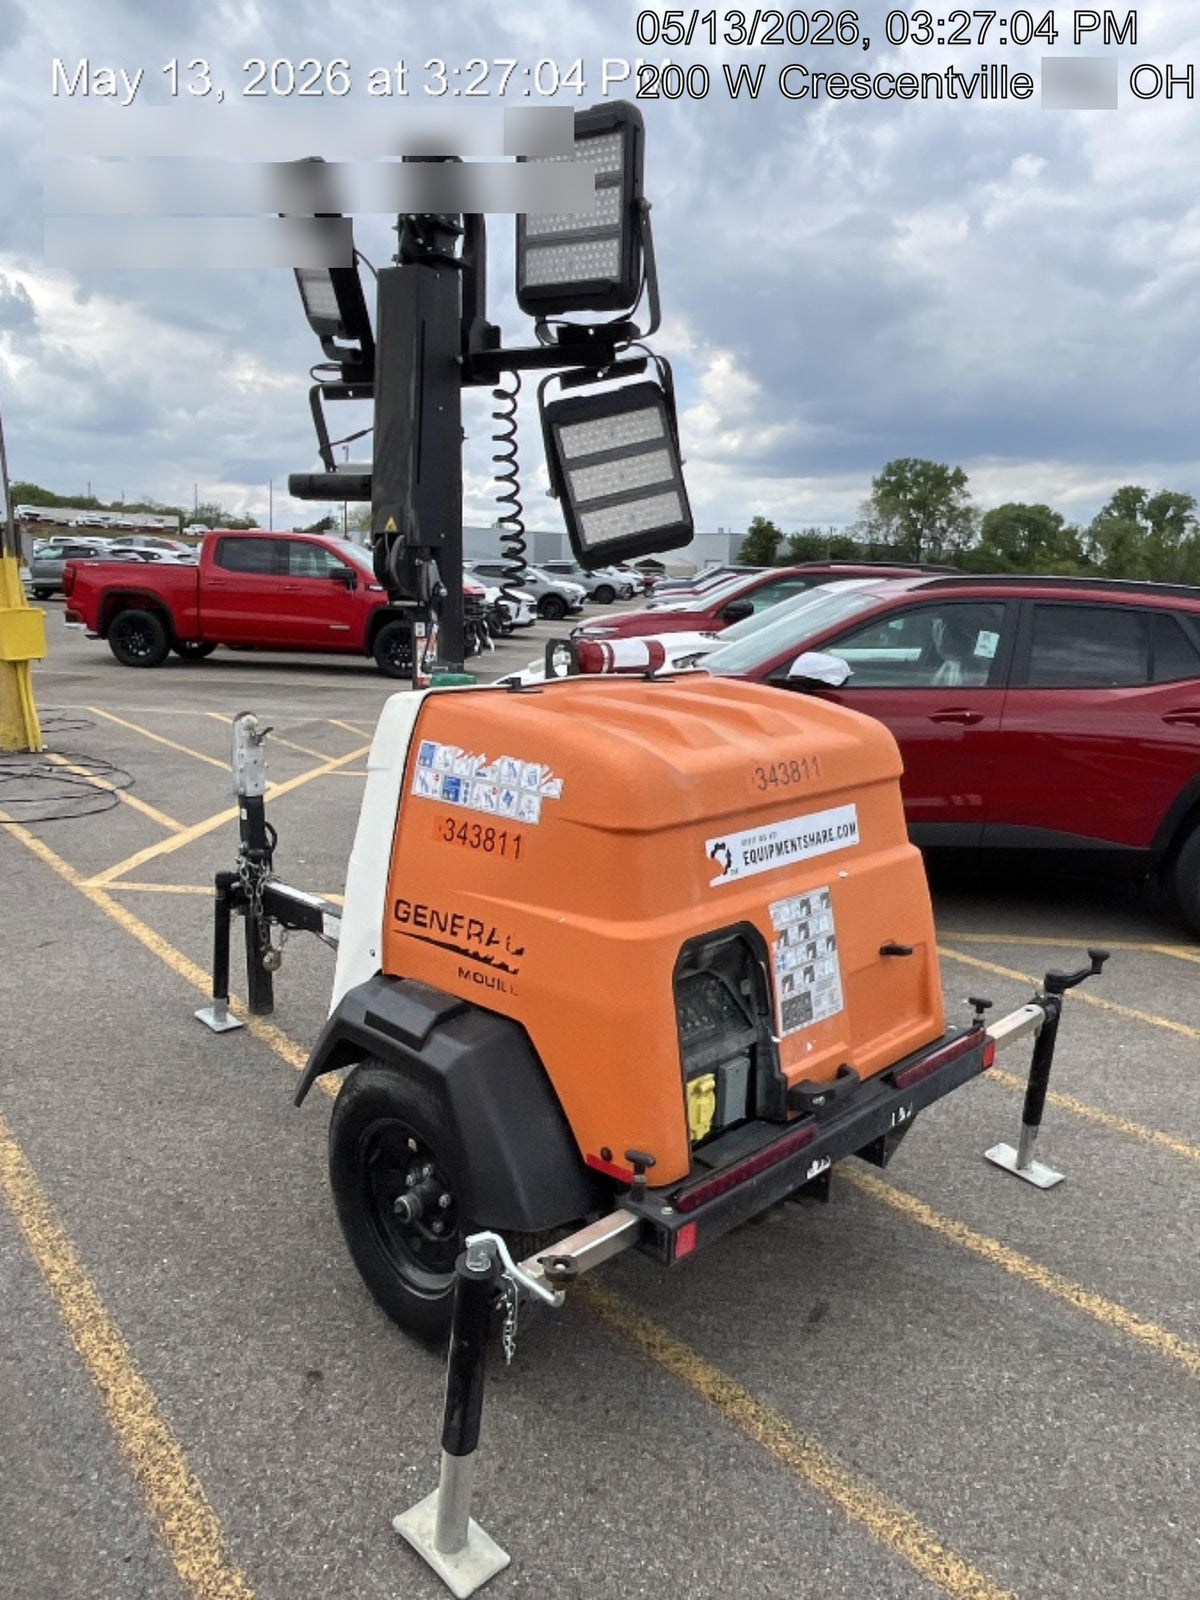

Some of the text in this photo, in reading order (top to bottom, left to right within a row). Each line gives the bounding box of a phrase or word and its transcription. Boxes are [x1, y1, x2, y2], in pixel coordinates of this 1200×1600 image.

[755, 756, 820, 791] 343811
[443, 817, 521, 860] 343811
[743, 821, 856, 867] EQUIPMENTSHARE.COM
